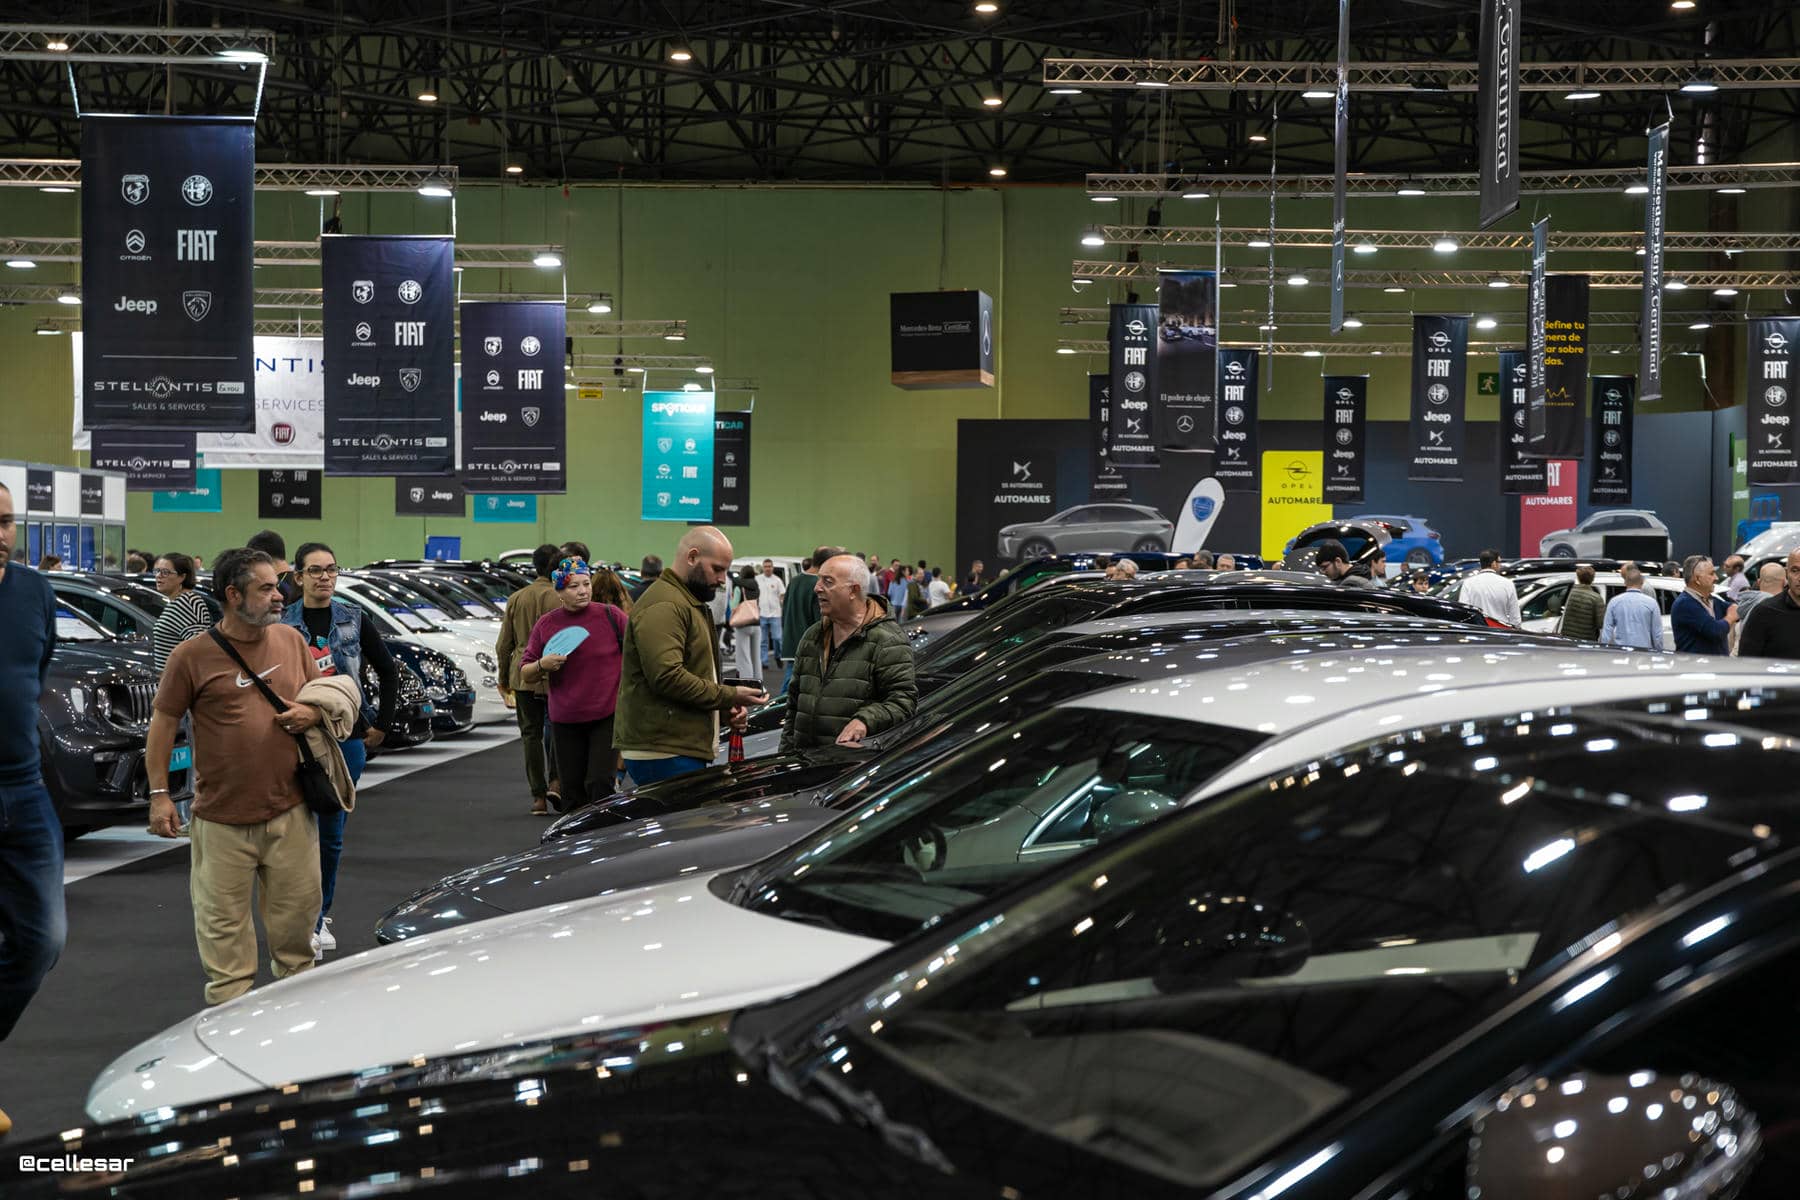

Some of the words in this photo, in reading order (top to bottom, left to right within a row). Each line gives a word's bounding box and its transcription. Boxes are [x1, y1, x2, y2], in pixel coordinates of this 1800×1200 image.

[177, 230, 217, 261] FIAT
[114, 296, 157, 315] Jeep
[395, 322, 426, 346] FIAT
[1568, 332, 1581, 341] de
[1558, 345, 1584, 353] sobre
[1124, 347, 1147, 365] FIAT
[1427, 359, 1451, 377] FIAT
[1764, 361, 1788, 379] FIAT
[347, 373, 380, 388] Jeep
[518, 370, 543, 389] FIAT
[94, 381, 213, 393] STELLANTIS
[1224, 385, 1245, 400] FIAT
[132, 402, 157, 410] SALES
[168, 403, 206, 411] SERVICES
[1121, 399, 1148, 412] Jeep
[480, 411, 507, 423] Jeep
[1335, 410, 1354, 423] FIAT
[1424, 411, 1451, 423] Jeep
[1603, 411, 1622, 425] FIAT
[1761, 414, 1789, 426] Jeep
[275, 427, 290, 440] FIAT
[1222, 431, 1246, 441] Jeep
[332, 437, 423, 447] STELLANTIS
[1333, 450, 1355, 459] Jeep
[1600, 452, 1622, 461] Jeep
[96, 459, 170, 468] STELLANTIS
[468, 462, 541, 470] STELLANTIS
[1414, 457, 1457, 465] AUTOMARES
[432, 491, 453, 501] Jeep
[679, 496, 700, 505] Jeep
[994, 495, 1050, 503] AUTOMARES
[1268, 497, 1321, 505] AUTOMARE
[1526, 497, 1573, 505] AUTOMARES
